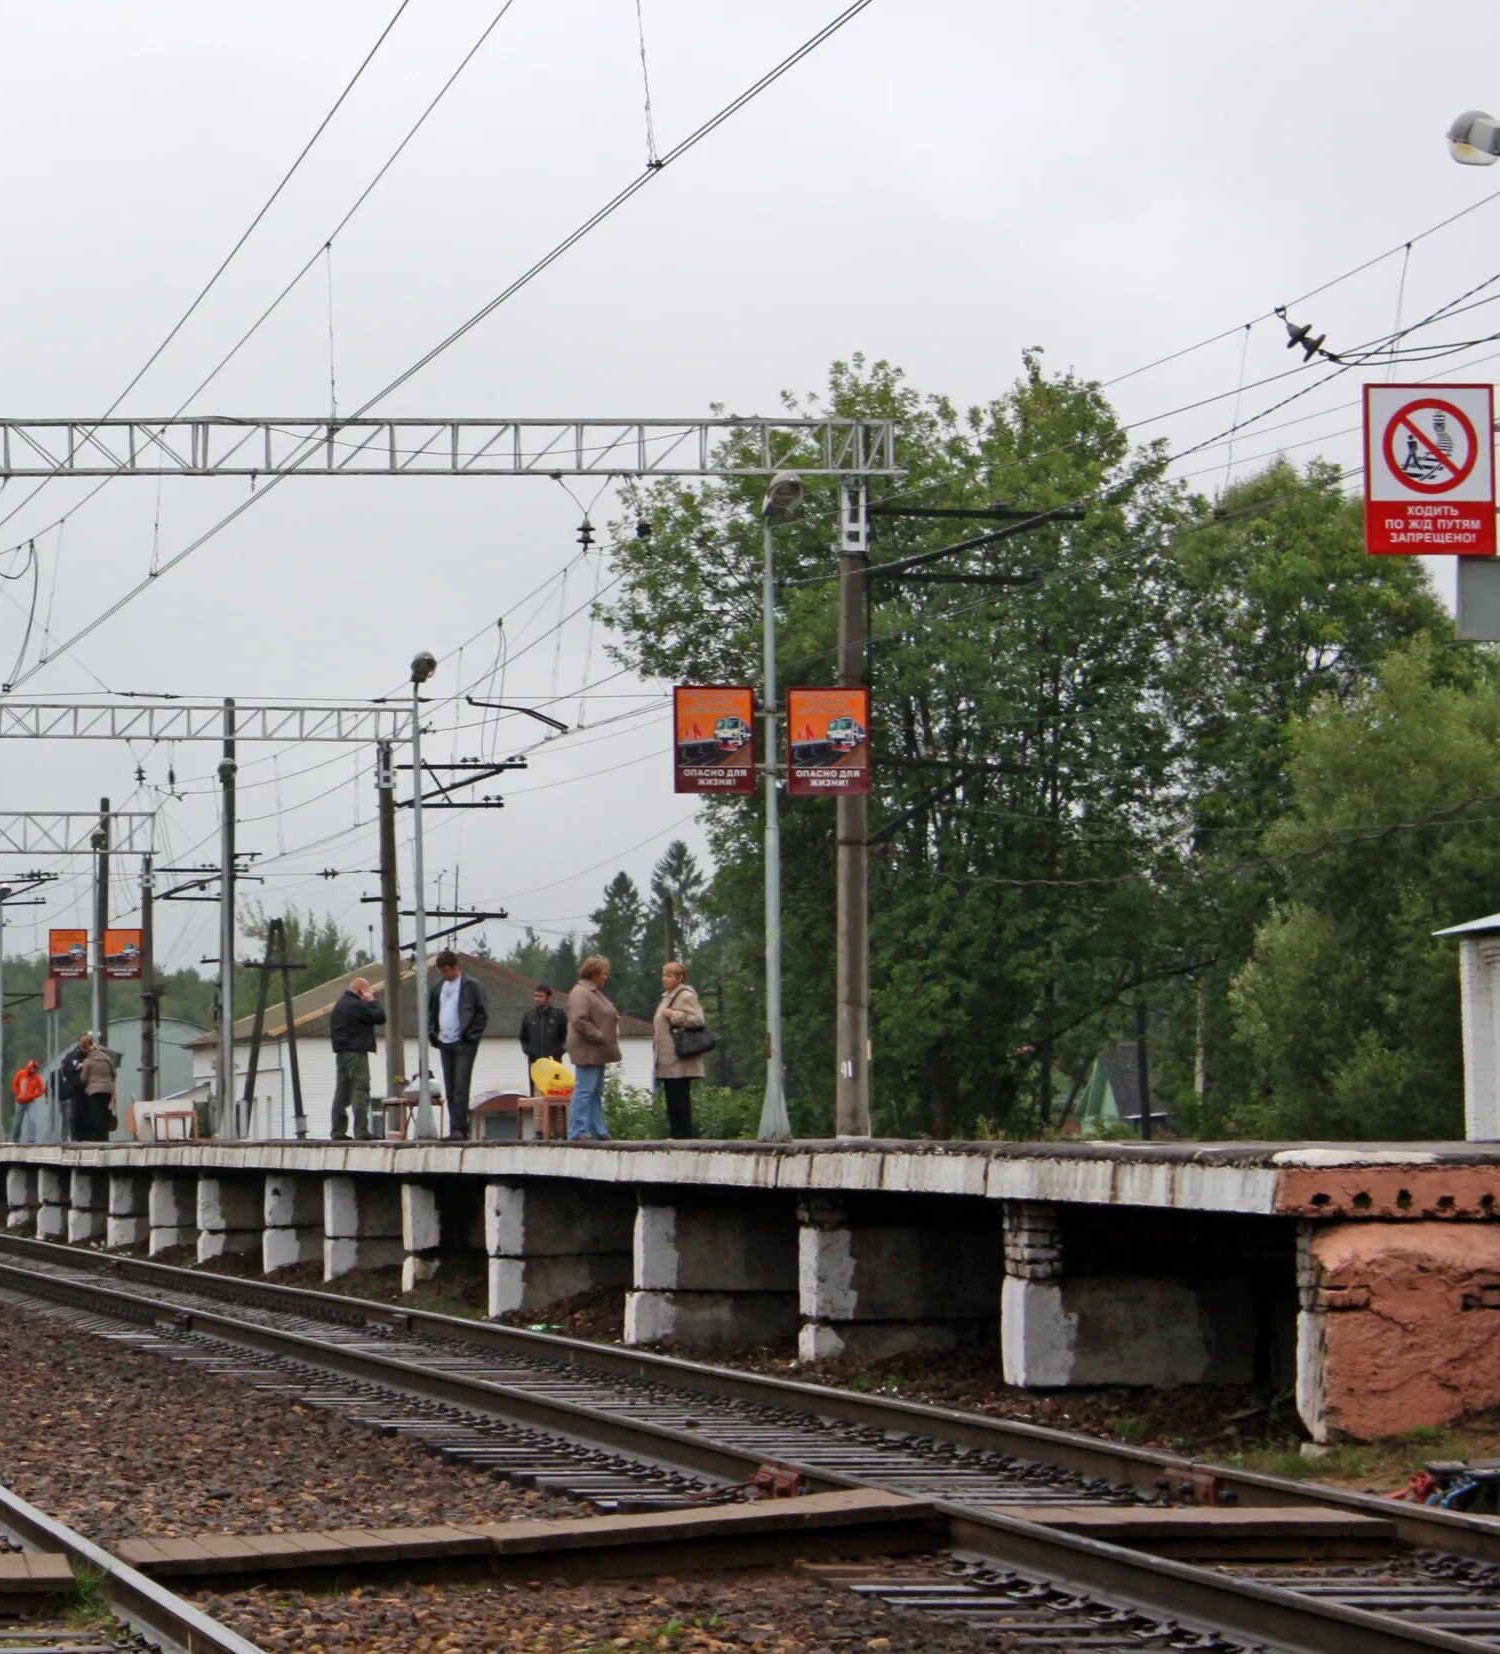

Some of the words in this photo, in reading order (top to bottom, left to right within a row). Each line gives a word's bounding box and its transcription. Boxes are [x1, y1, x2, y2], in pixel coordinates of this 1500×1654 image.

[1407, 505, 1459, 516] ХОДИТЬ
[1385, 519, 1404, 529] ПО
[1408, 519, 1433, 531] Ж/Д
[1437, 519, 1481, 530] ПУТЯМ
[1390, 532, 1476, 543] ЗАПРЕЩЕНО!
[683, 769, 725, 777] ОПАСНО
[726, 769, 748, 778] ДЛЯ
[795, 769, 837, 778] ОПАСНО
[839, 769, 861, 779] ДЛЯ
[697, 778, 736, 786] ЖИЗНИ!
[809, 778, 849, 787] ЖИЗНИ!
[840, 1061, 853, 1078] 41
